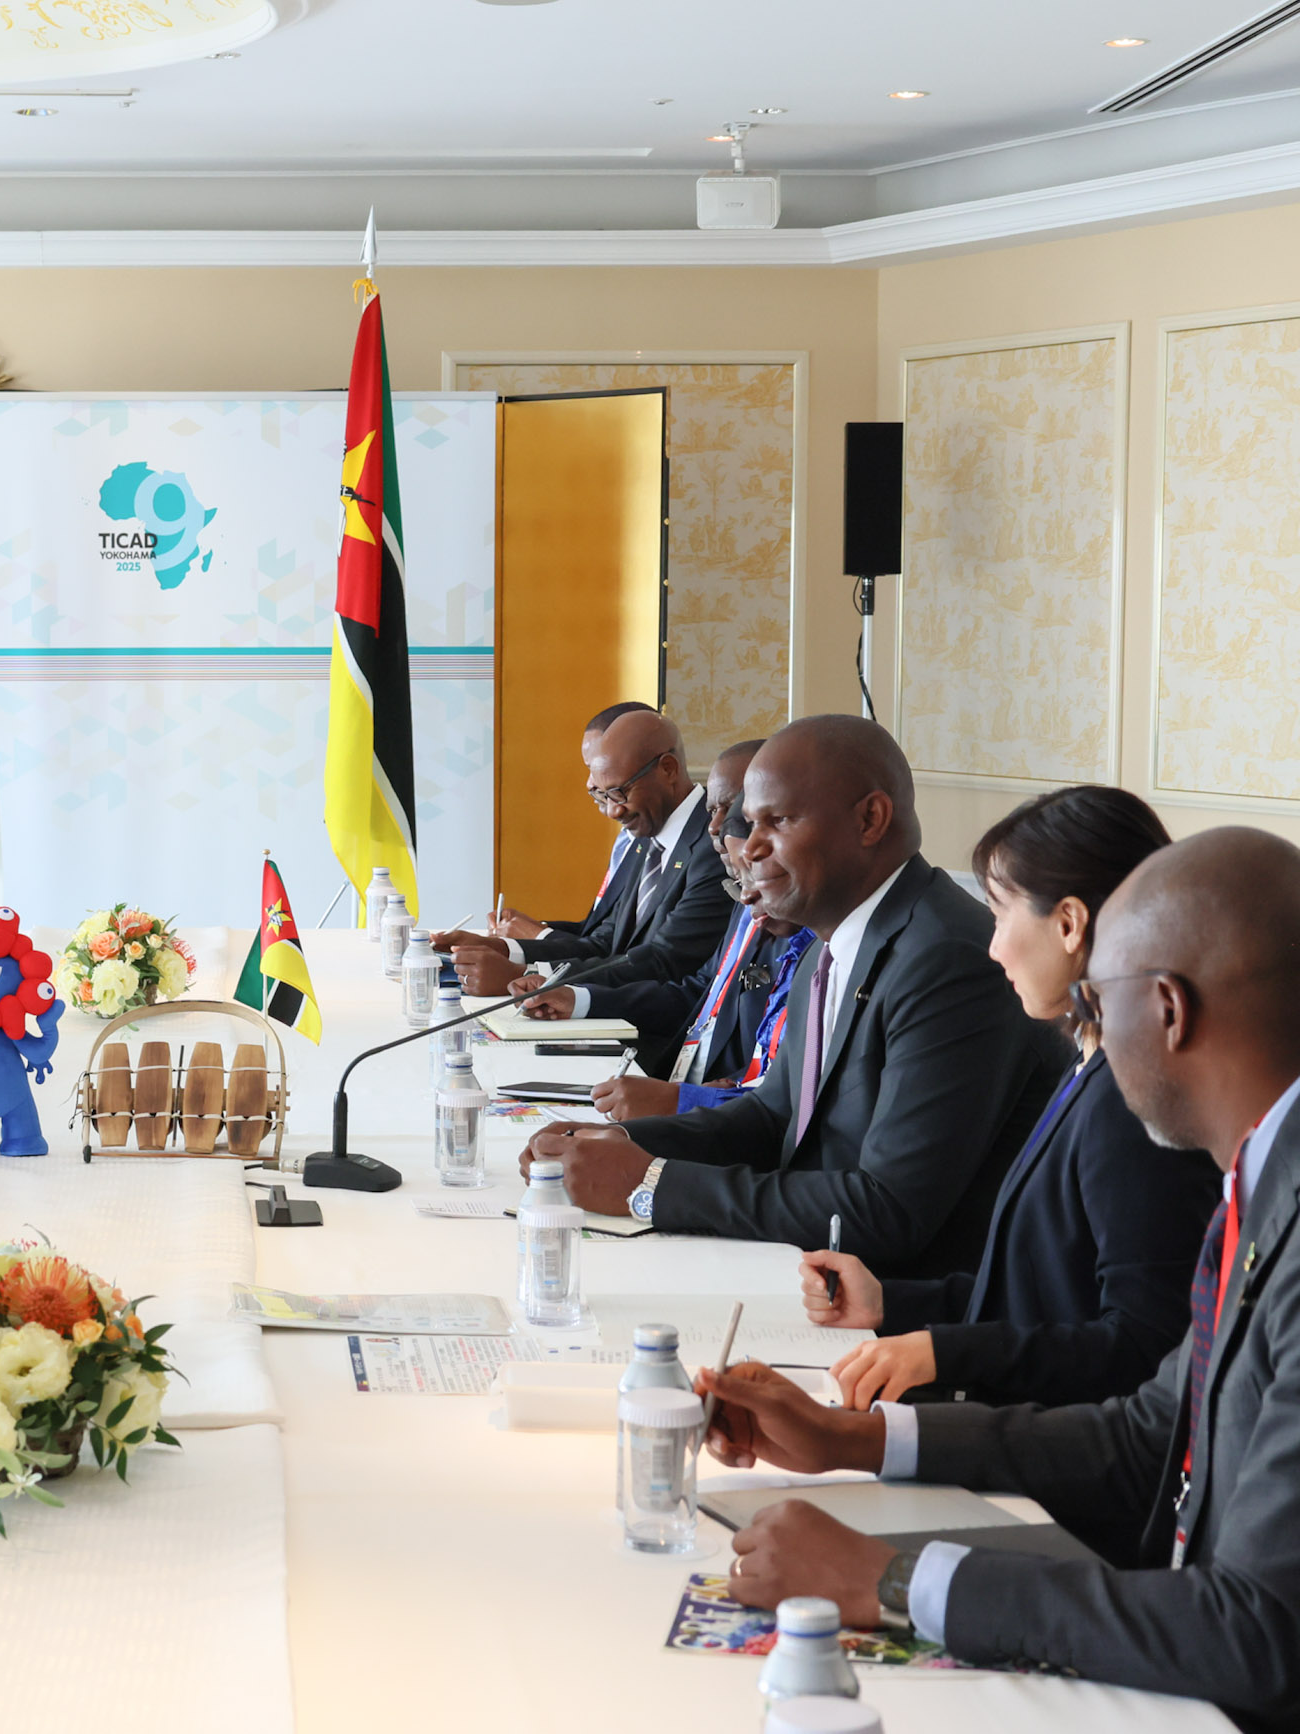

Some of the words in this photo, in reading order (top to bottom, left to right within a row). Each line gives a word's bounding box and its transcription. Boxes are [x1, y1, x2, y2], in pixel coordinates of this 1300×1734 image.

[133, 469, 205, 571] 9
[98, 533, 158, 549] TICAD
[100, 551, 157, 560] YOKOHAMA
[116, 562, 141, 571] 2025
